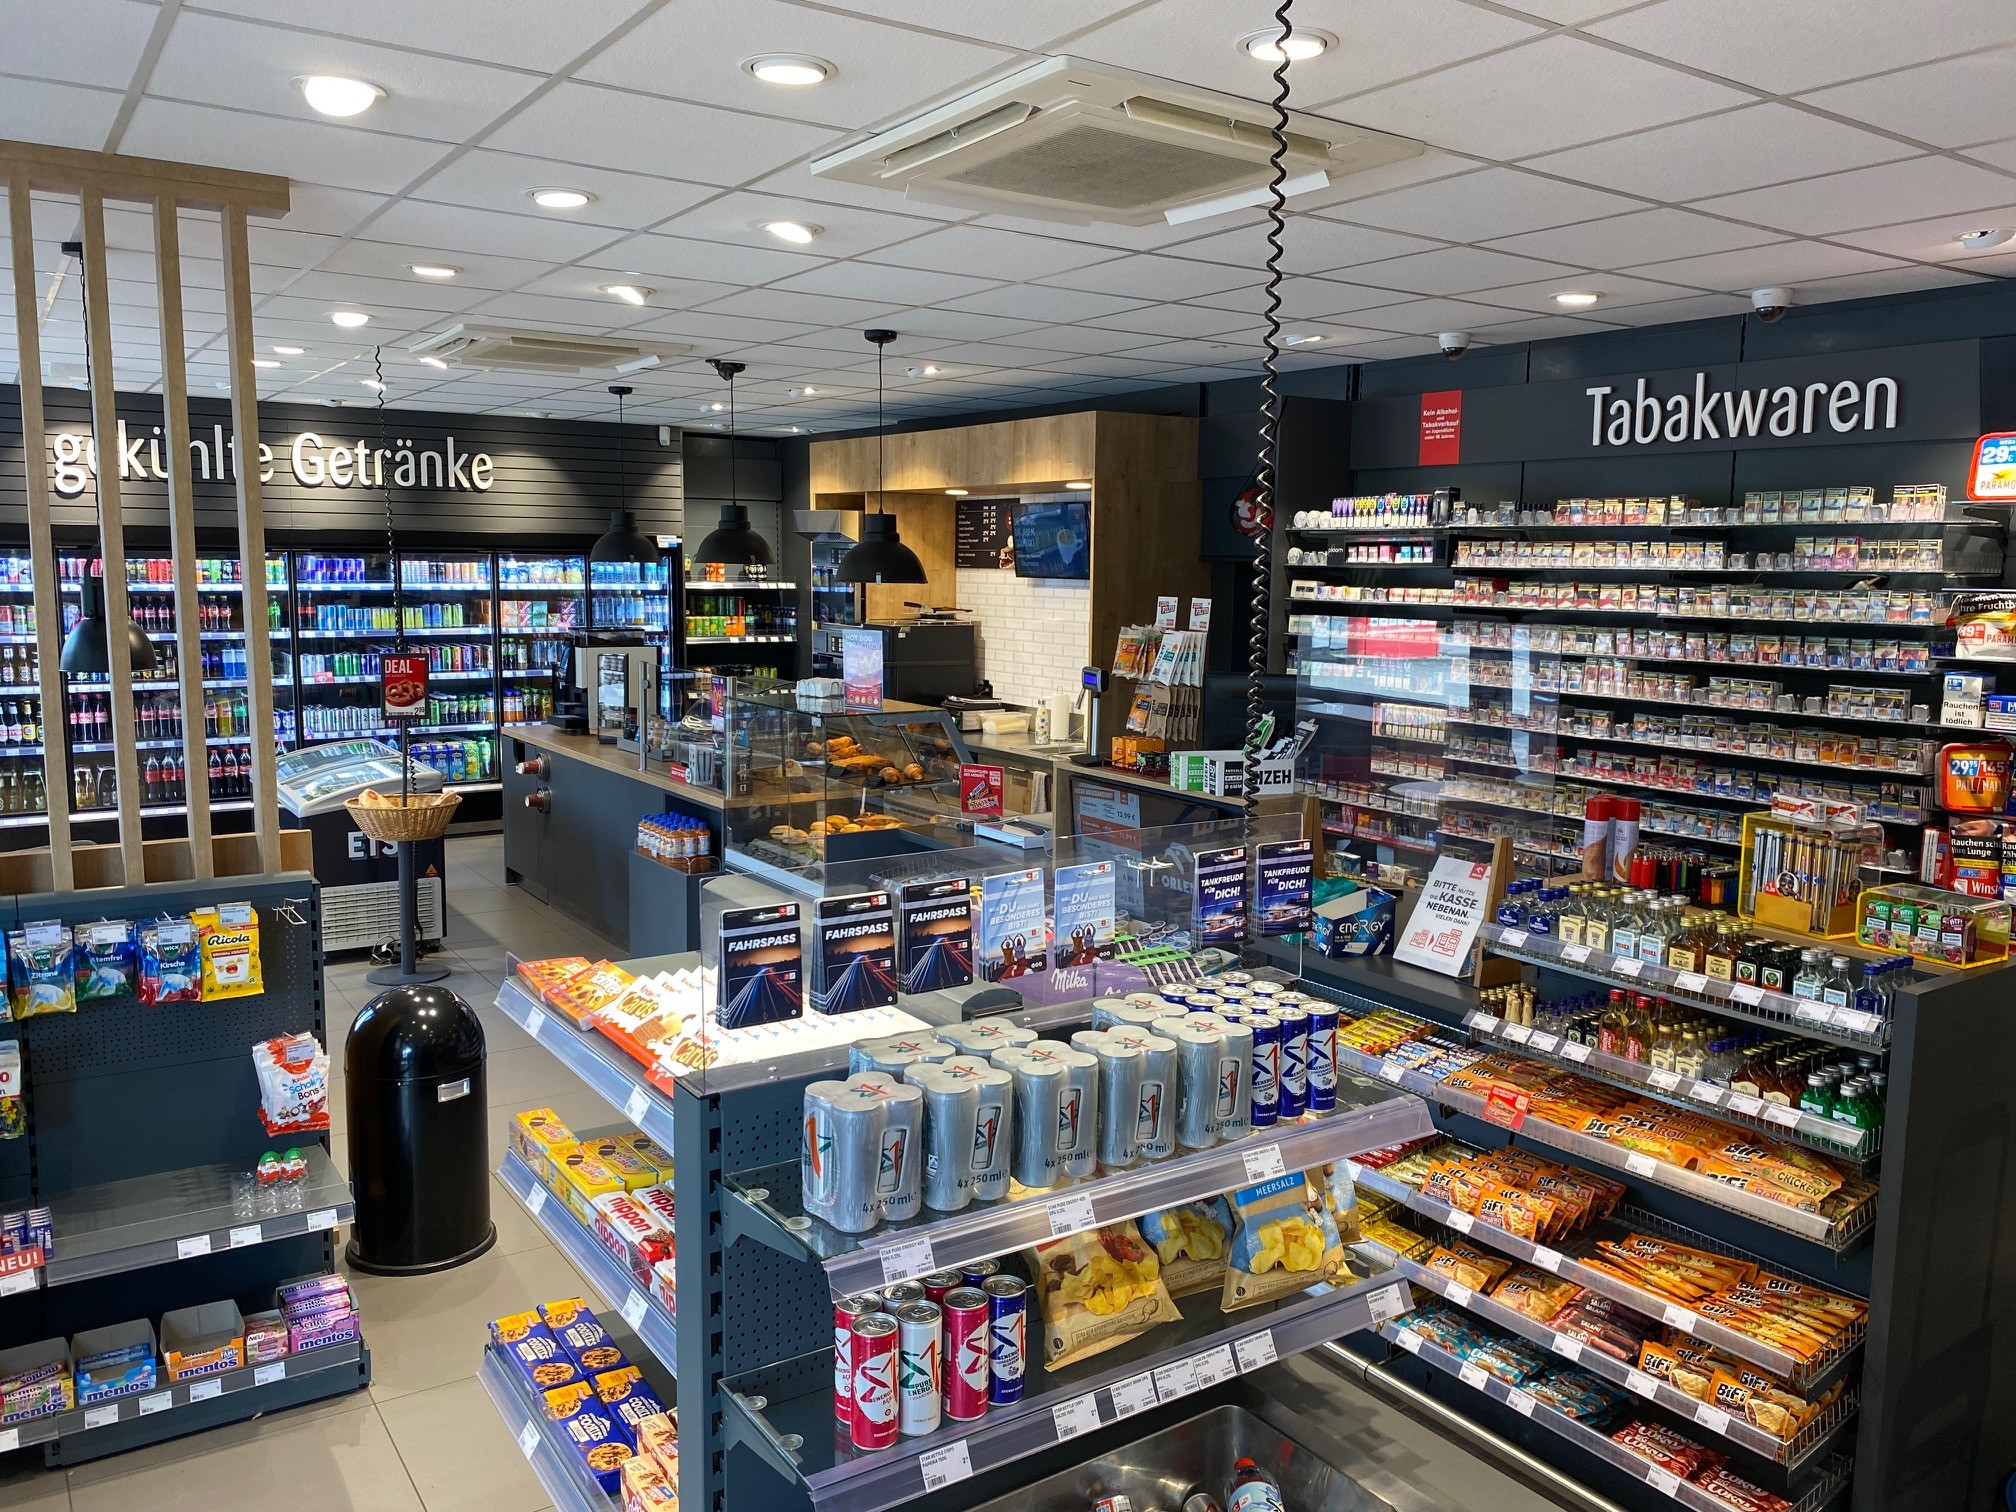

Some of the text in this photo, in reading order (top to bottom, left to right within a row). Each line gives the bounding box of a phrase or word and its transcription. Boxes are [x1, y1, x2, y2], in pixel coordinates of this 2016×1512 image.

[1437, 408, 1459, 416] Alkohol-
[1585, 372, 1898, 447] Tabakwaren
[1422, 420, 1459, 428] Tabakverkauf
[291, 430, 494, 492] Getränke
[1982, 445, 2010, 464] 29
[384, 660, 413, 674] DEAL
[1944, 701, 1978, 710] Rauchen
[1954, 708, 1965, 717] ist
[1946, 716, 1973, 726] tödlich
[1952, 760, 1969, 775] 29
[1117, 810, 1131, 820] 13,99
[348, 832, 398, 858] EIS
[1952, 838, 1984, 848] Rauchen
[1967, 848, 1992, 858] Lunge
[1264, 866, 1310, 878] TANKFREUDE
[1160, 874, 1194, 895] ORLE
[1201, 872, 1244, 888] TANKFREUDE
[1278, 879, 1306, 891] DICH!
[1214, 886, 1240, 900] DICH!
[1433, 879, 1476, 896] BITTE NUTZE
[1072, 892, 1089, 903] DU
[1438, 892, 1478, 910] KASSE
[1000, 901, 1017, 913] DU
[1062, 900, 1111, 914] BESONDERES
[1426, 902, 1469, 918] NEBENAN.
[910, 906, 967, 923] FAHRSPASS
[990, 908, 1040, 924] BESONDERES
[1078, 910, 1098, 919] BIST!
[1435, 914, 1470, 926] VIELEN DANK!
[826, 922, 888, 940] FAHRSPASS
[1008, 920, 1028, 930] BIST!
[207, 934, 250, 946] Ricola
[728, 933, 796, 953] FAHRSPASS
[164, 944, 180, 952] WICK
[90, 953, 122, 963] Atemfrei
[160, 958, 186, 970] Kirsche
[30, 968, 58, 980] Zitrone
[1051, 968, 1088, 993] Milka
[616, 991, 660, 1018] Cards
[670, 1037, 718, 1069] Cards
[297, 1087, 320, 1100] Bons
[1205, 1120, 1231, 1134] 4x 250
[1045, 1153, 1073, 1168] 4x 250
[1123, 1149, 1134, 1159] 4x
[957, 1174, 987, 1189] 4x 250
[1256, 1176, 1295, 1197] MEERSALZ
[1777, 1172, 1820, 1197] CHICKEN
[862, 1196, 896, 1214] 4x 250
[608, 1196, 652, 1234] nippon
[594, 1216, 627, 1260] nippon
[892, 1245, 902, 1254] PURE
[902, 1242, 917, 1252] ENERGY
[0, 1251, 38, 1272] NEU!
[1590, 1299, 1611, 1311] SALAMI
[1581, 1320, 1602, 1333] SALAMI
[248, 1333, 264, 1342] NEU
[299, 1329, 353, 1350] mentos
[1566, 1330, 1588, 1342] SALAMI
[177, 1357, 238, 1380] mentos
[134, 1372, 148, 1381] mint
[914, 1378, 932, 1389] PURE
[86, 1380, 149, 1402] mentos
[908, 1386, 933, 1397] ENERGY
[2, 1400, 66, 1423] mentos
[1062, 1403, 1074, 1411] KETTLE
[578, 1414, 601, 1442] COOKIES
[930, 1450, 944, 1459] KETTLE
[944, 1447, 955, 1455] CHIPS
